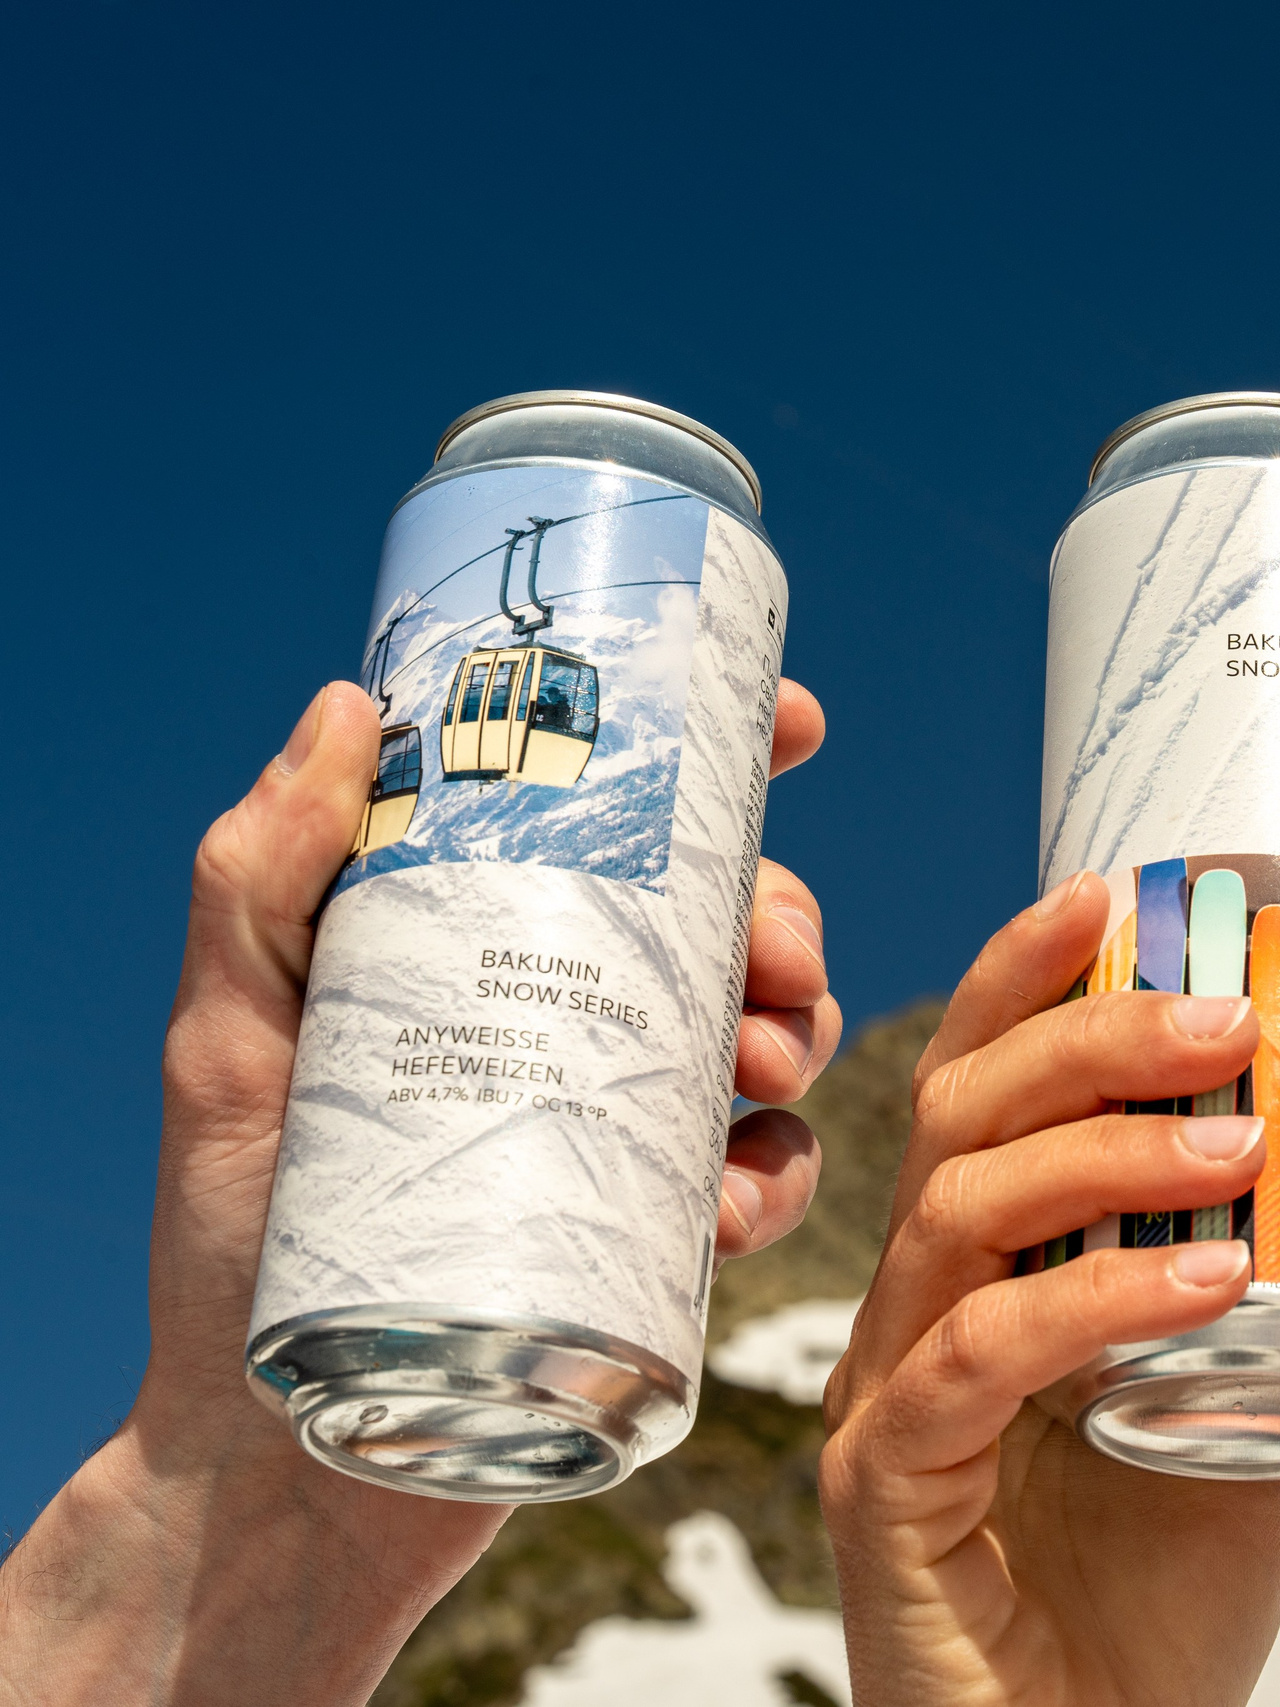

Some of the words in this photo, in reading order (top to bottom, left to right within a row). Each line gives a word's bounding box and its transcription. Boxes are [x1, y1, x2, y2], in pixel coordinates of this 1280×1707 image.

[480, 949, 602, 985] BAKUNIN
[476, 979, 562, 1005] SNOW
[568, 991, 649, 1030] SERIES
[395, 1025, 551, 1052] ANYWEISSE
[392, 1055, 564, 1086] HEFEWEIZEN
[386, 1087, 424, 1104] ABV
[426, 1086, 469, 1103] 4,7%
[476, 1088, 510, 1105] IBU
[514, 1092, 524, 1105] 7
[532, 1094, 561, 1113] OG
